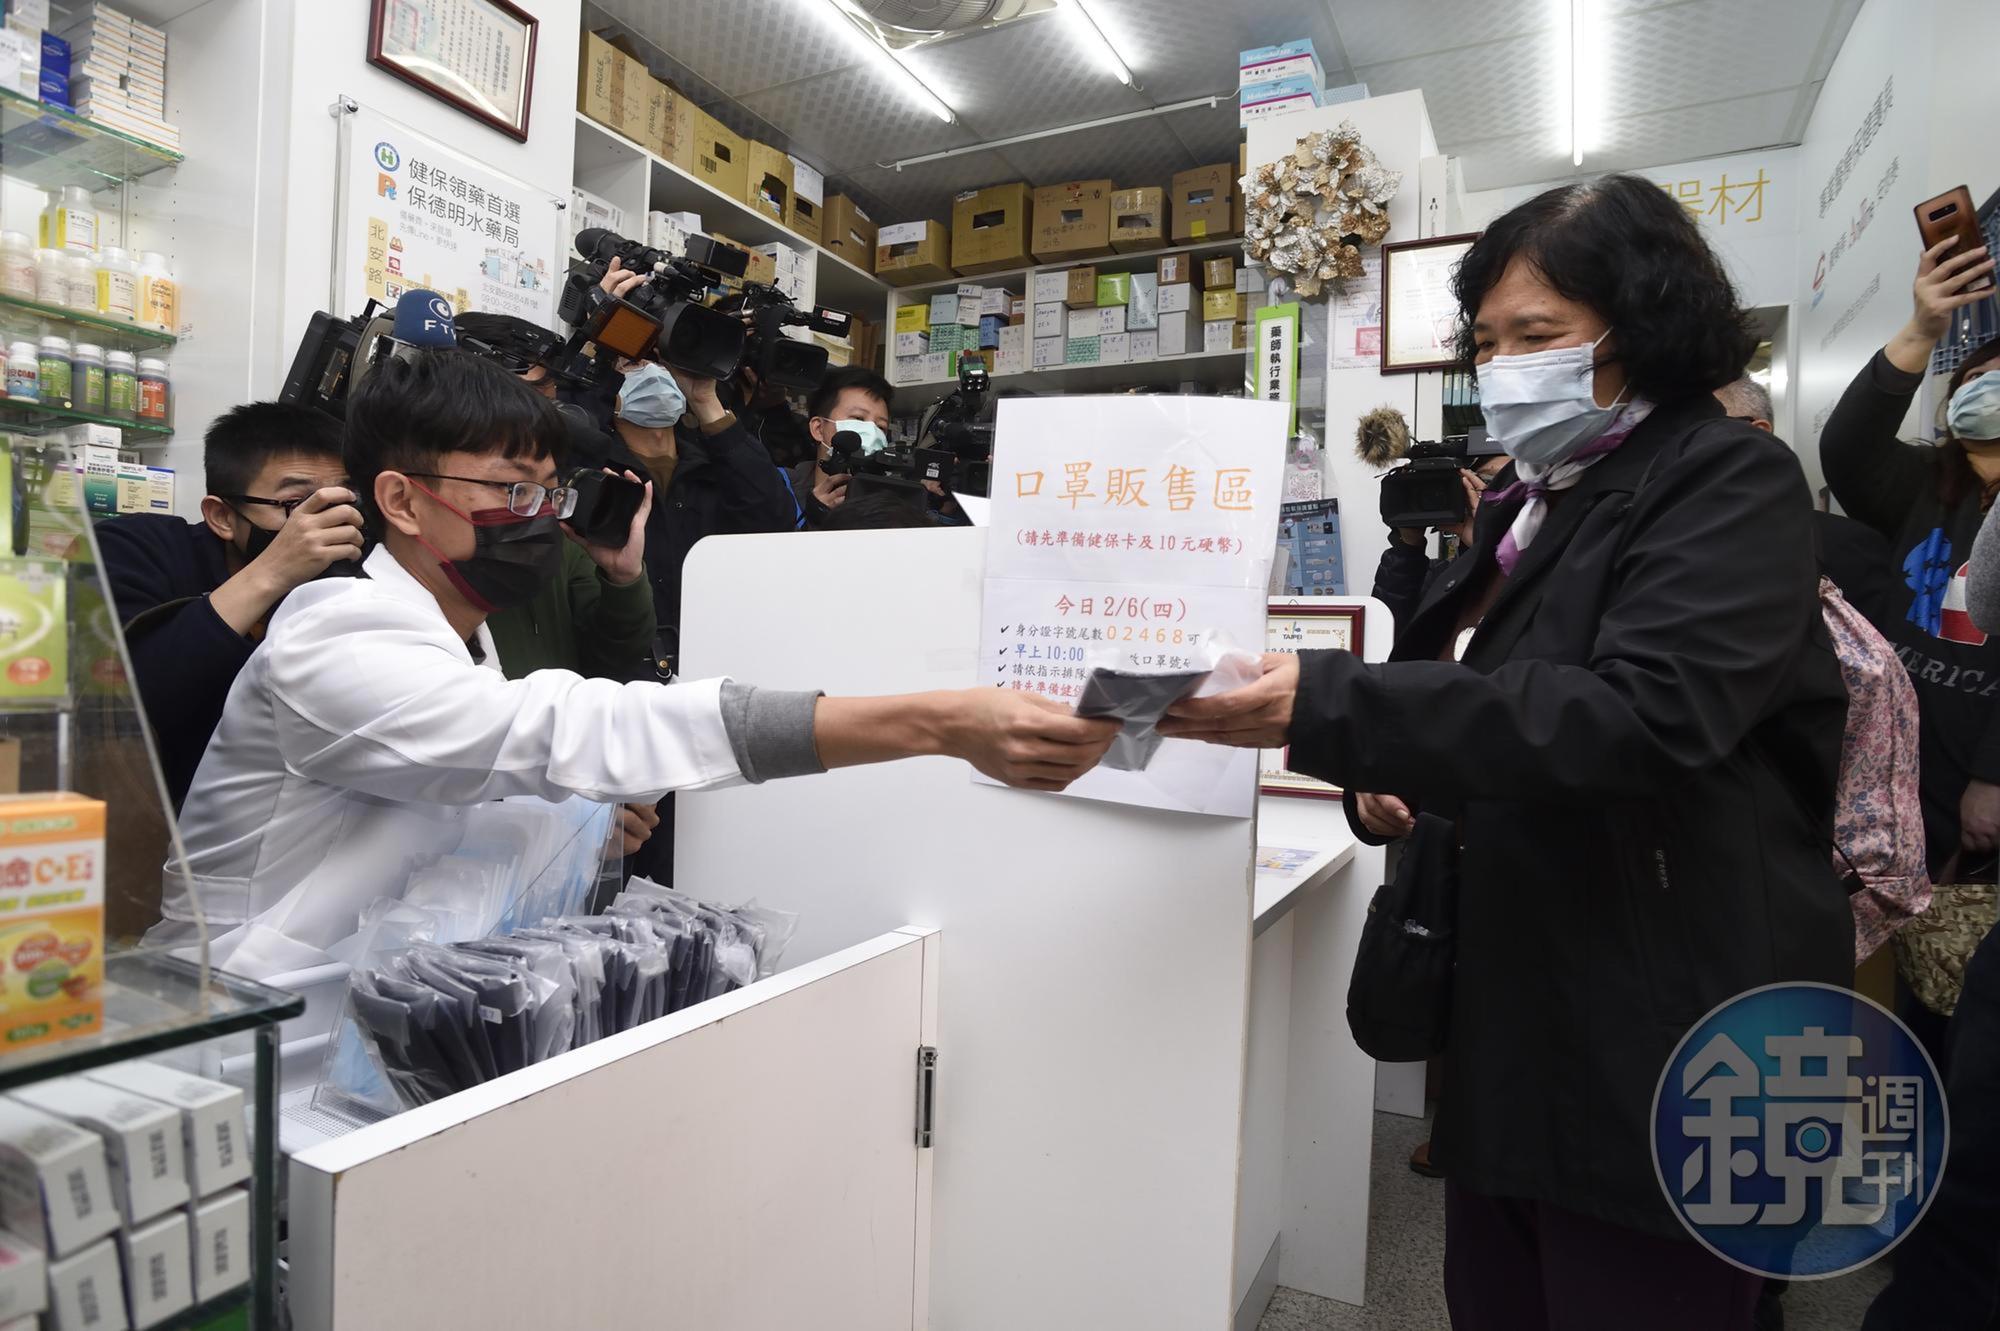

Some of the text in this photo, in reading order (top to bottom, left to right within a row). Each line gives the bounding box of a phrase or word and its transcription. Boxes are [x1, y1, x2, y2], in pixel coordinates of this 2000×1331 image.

[595, 59, 605, 98] FRAGILE
[408, 157, 520, 225] 健保領藥首選
[407, 185, 519, 248] 保德明水藥局
[368, 224, 385, 284] 北安路
[1015, 461, 1254, 511] 口罩販售區
[1016, 529, 1244, 556] (請先準備健保卡及10元硬幣)
[1012, 663, 1088, 682] 請依指示排隊
[1014, 644, 1085, 662] 早上10:00
